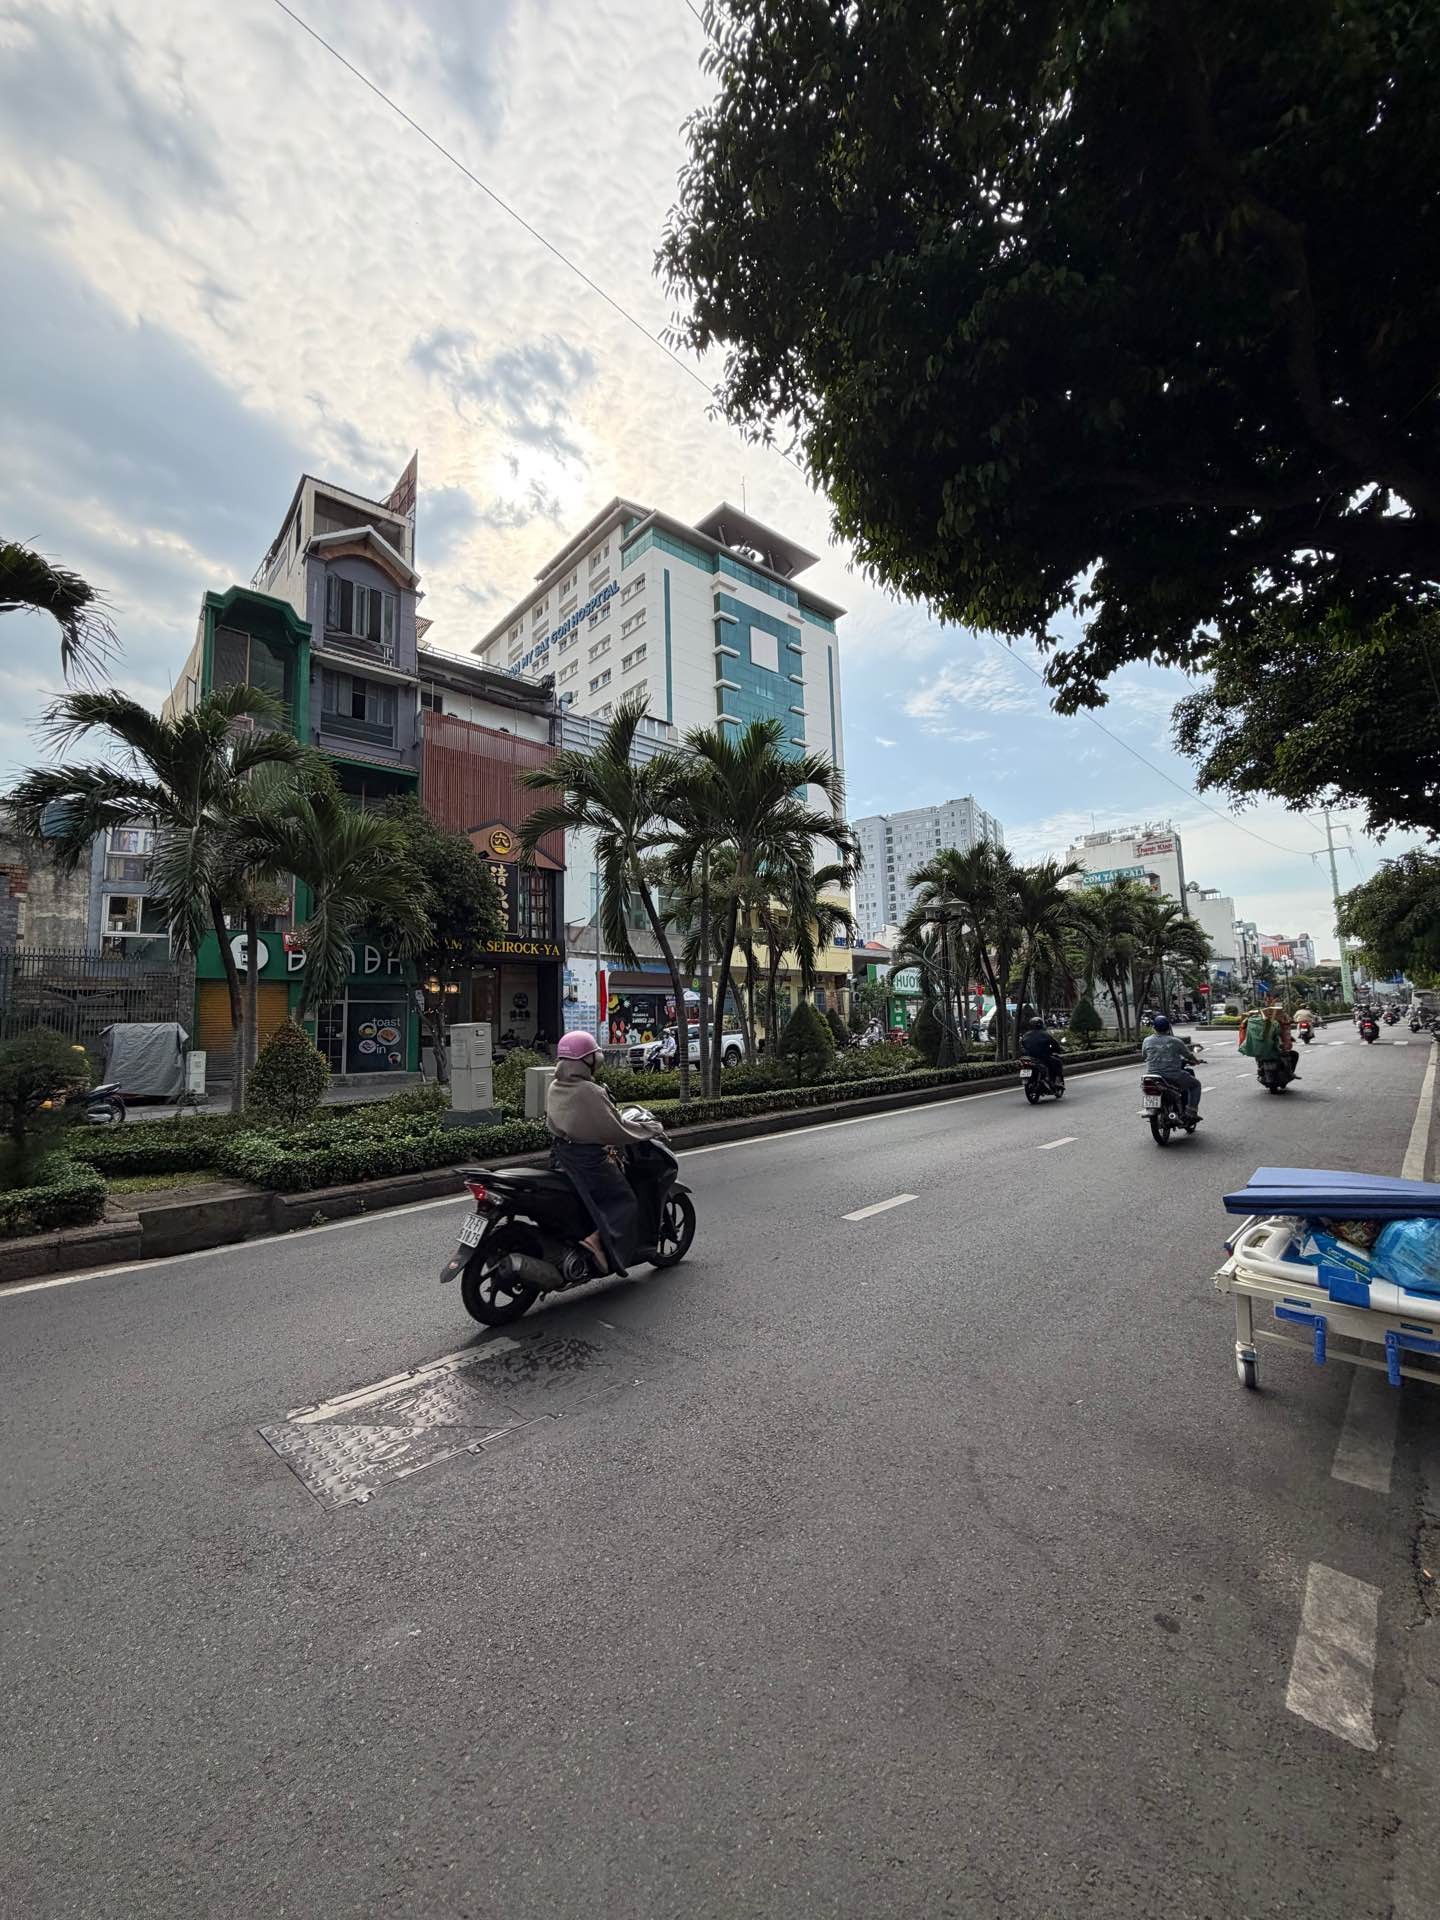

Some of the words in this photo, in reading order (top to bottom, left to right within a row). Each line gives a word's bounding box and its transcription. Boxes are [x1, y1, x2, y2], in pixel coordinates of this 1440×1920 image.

[550, 618, 571, 645] GON
[571, 579, 620, 629] HOSPITAL
[486, 940, 560, 956] SEIROCK-YA
[371, 1017, 401, 1027] toast
[376, 1044, 386, 1054] in
